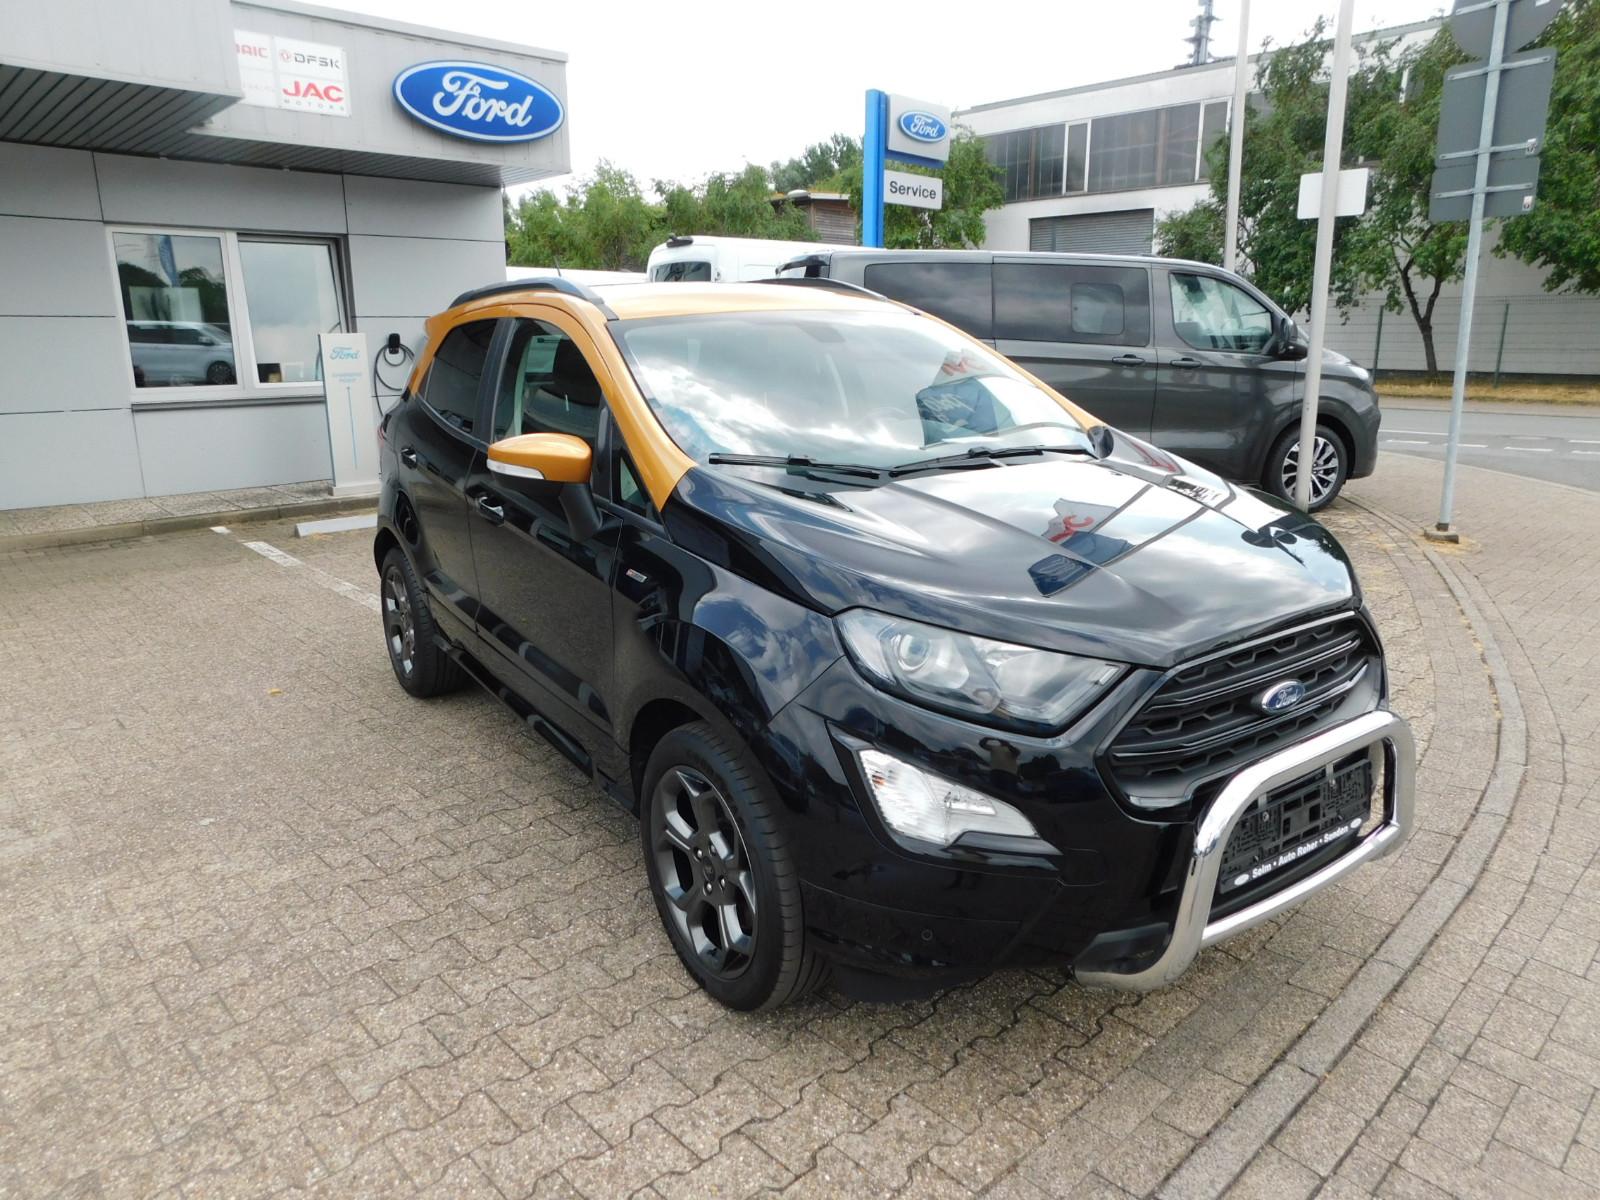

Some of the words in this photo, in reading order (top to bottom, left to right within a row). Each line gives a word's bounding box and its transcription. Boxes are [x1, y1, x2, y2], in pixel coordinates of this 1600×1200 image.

[294, 53, 340, 69] DFSK
[282, 80, 344, 102] JAC
[432, 71, 534, 127] Ford
[284, 99, 344, 110] MOTORS
[910, 115, 939, 137] Ford
[889, 180, 937, 199] Service
[329, 346, 361, 360] Ford
[1275, 686, 1300, 708] Ford
[1252, 863, 1272, 878] Selm
[1278, 851, 1297, 866] Auto
[1324, 826, 1349, 842] Senden
